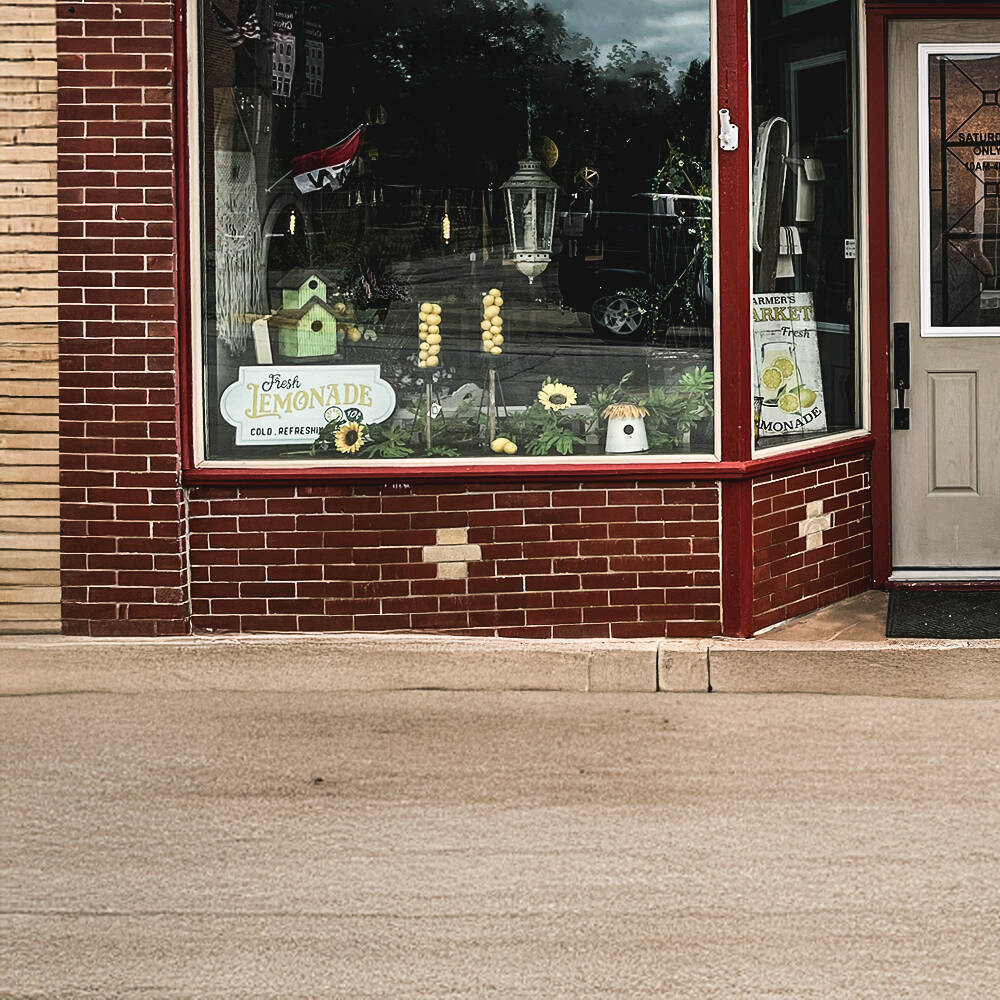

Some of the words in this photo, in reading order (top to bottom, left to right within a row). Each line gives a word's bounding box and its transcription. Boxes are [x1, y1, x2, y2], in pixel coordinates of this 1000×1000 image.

[781, 326, 810, 338] Fresh
[262, 374, 302, 392] Fresh
[244, 383, 372, 419] LEMONADE
